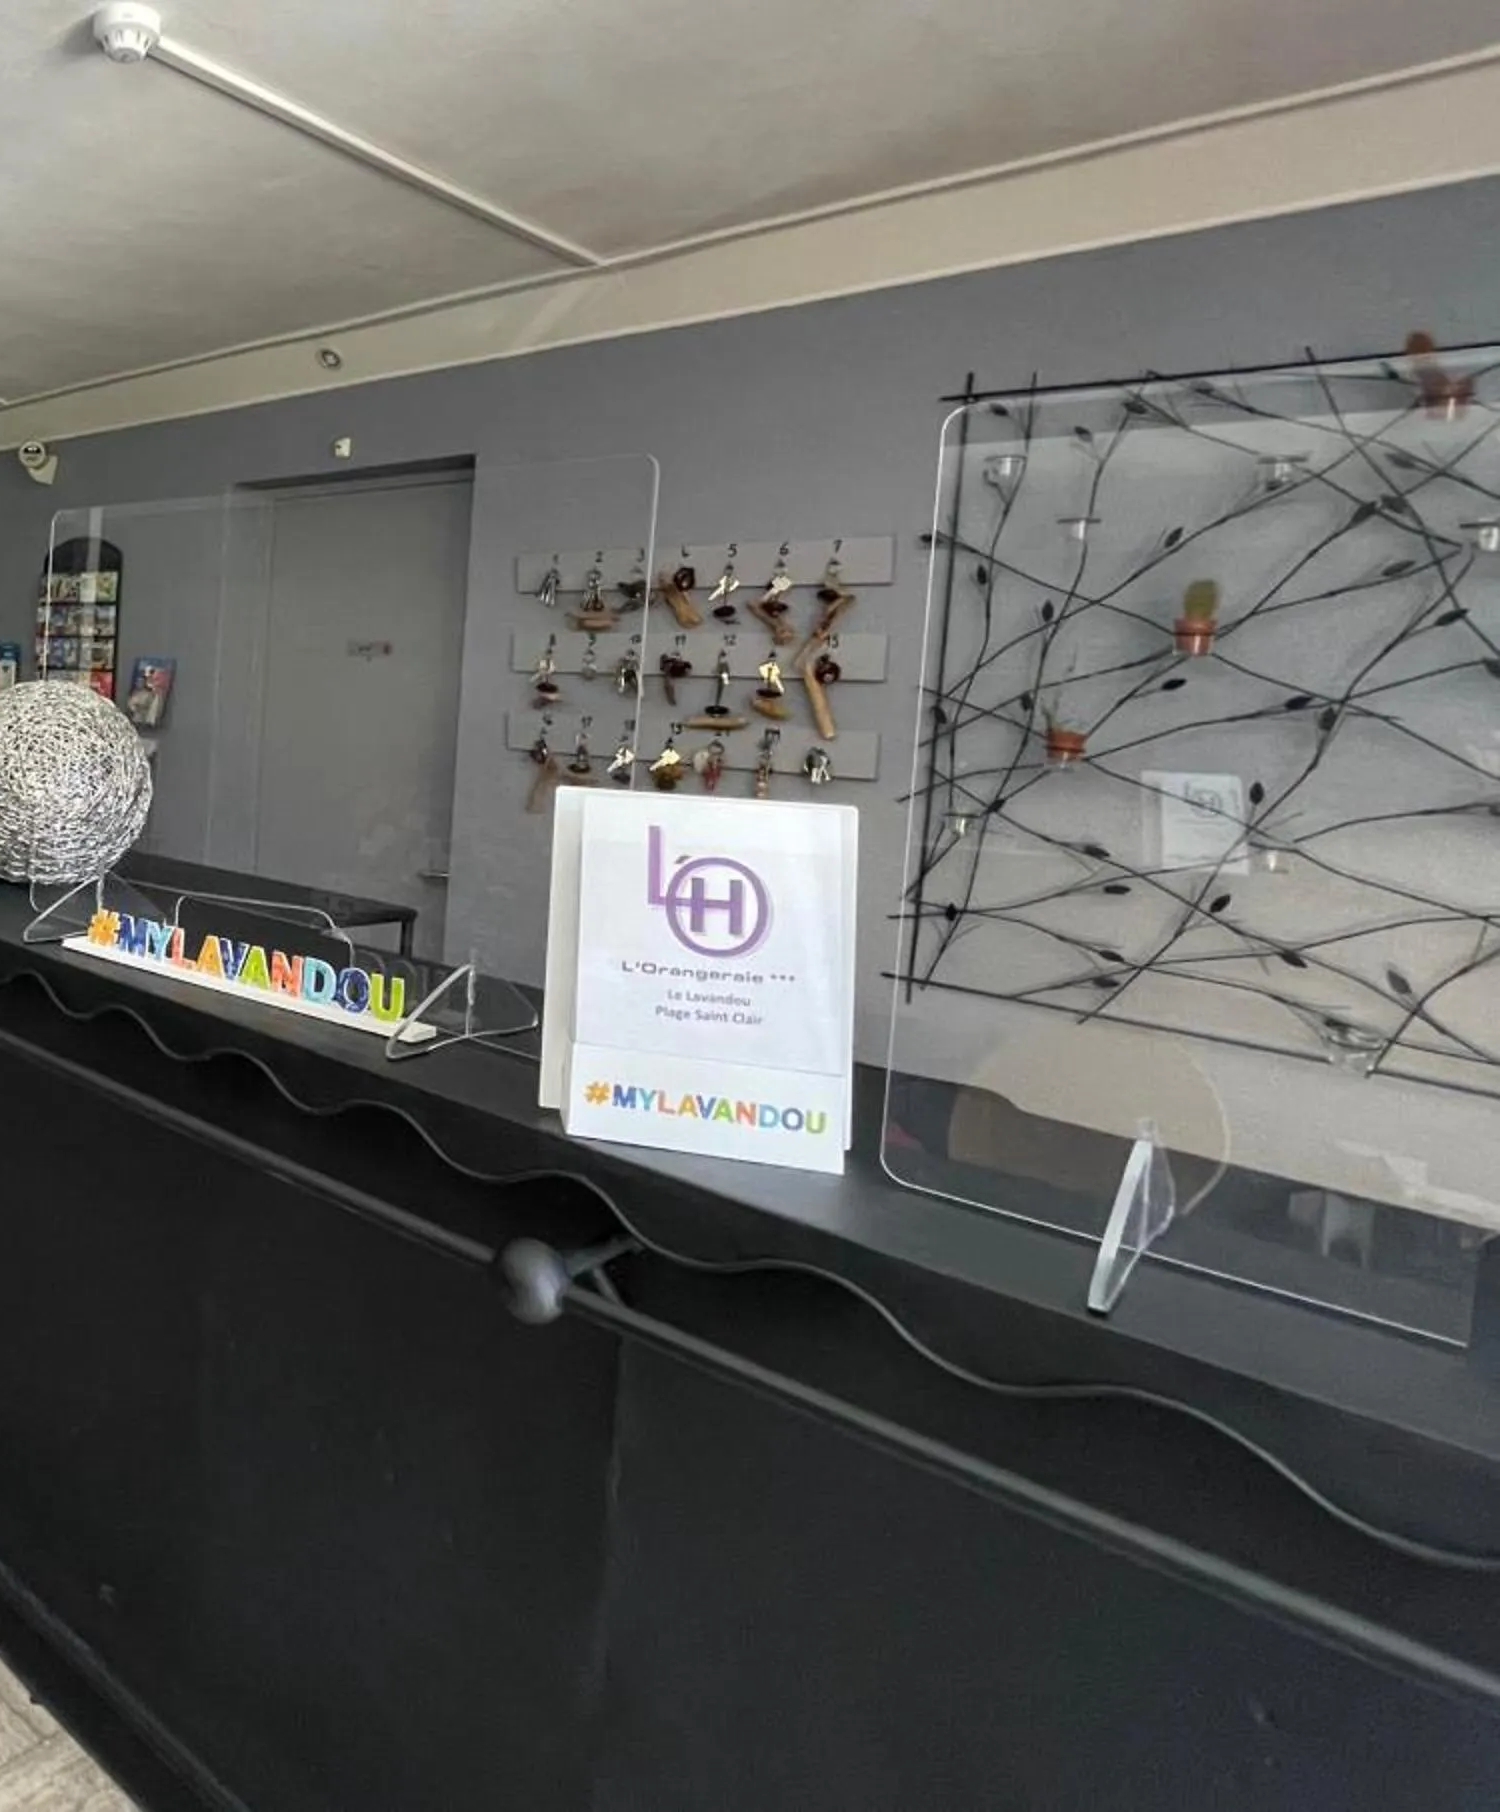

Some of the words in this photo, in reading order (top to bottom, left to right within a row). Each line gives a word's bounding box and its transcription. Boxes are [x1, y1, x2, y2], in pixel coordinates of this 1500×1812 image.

[727, 542, 738, 558] 5
[779, 539, 790, 556] 6
[833, 538, 843, 554] 7
[86, 908, 406, 1022] #MYLAVANDOU
[621, 960, 764, 984] L'Orangeraie
[667, 988, 683, 1001] Le
[685, 990, 752, 1008] Lavandou
[655, 1005, 691, 1022] Plage
[695, 1009, 729, 1024] Saint
[731, 1012, 764, 1026] Clair
[583, 1079, 827, 1135] #MYLAVANDOU
